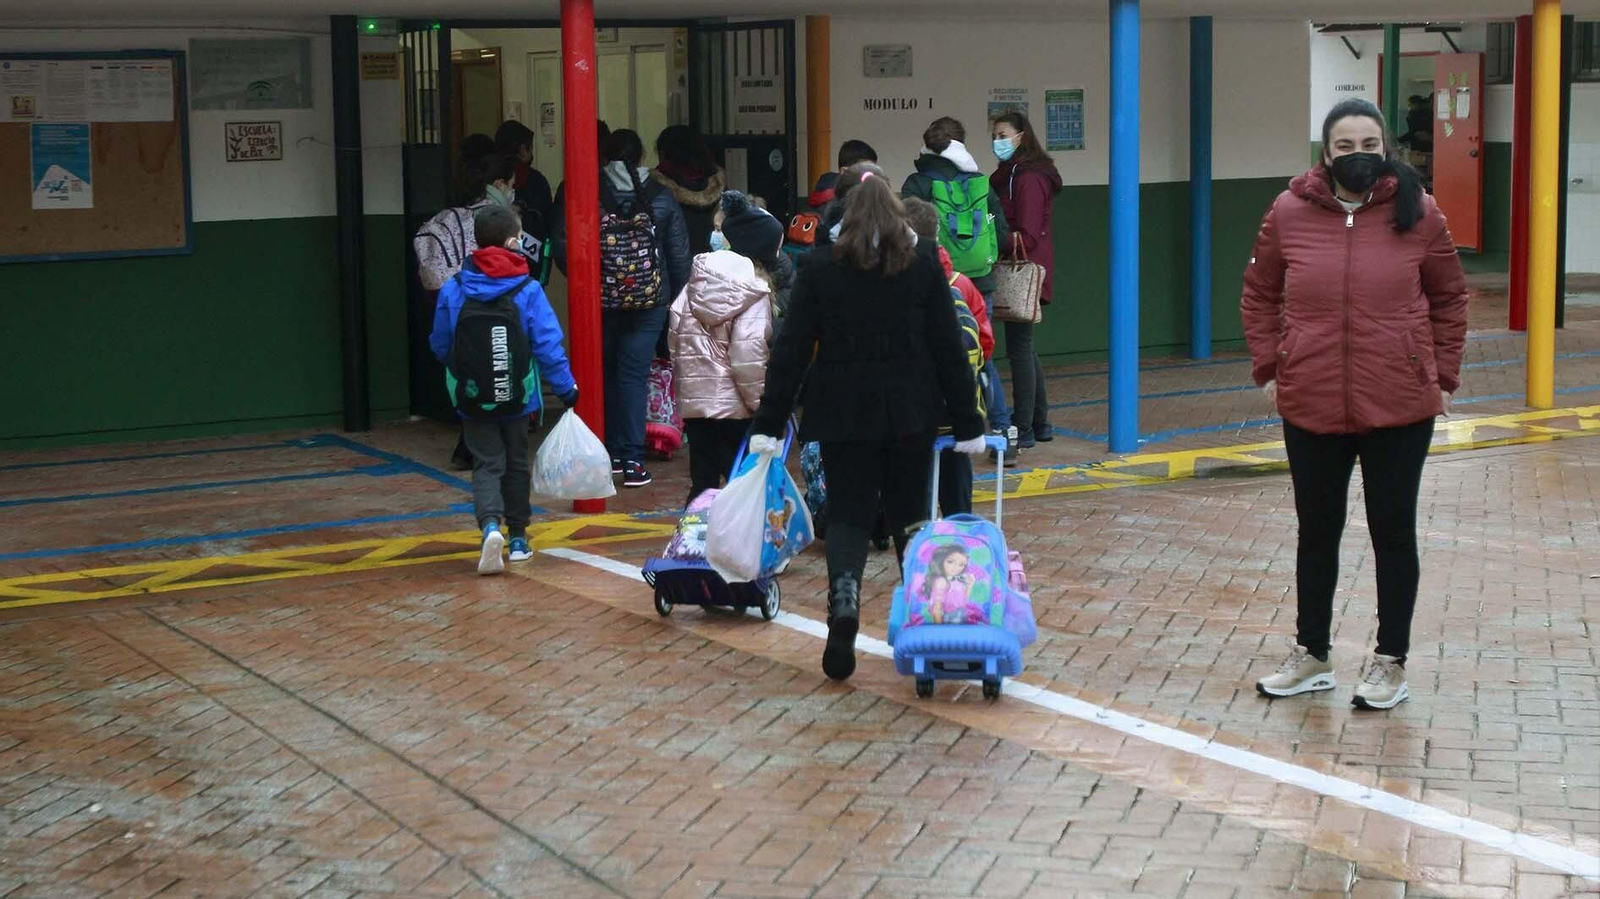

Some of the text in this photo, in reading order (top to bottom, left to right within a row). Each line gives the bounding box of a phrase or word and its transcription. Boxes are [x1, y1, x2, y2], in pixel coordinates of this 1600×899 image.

[863, 98, 918, 111] MODULO
[491, 325, 508, 371] MADRID
[494, 374, 510, 402] REAL
